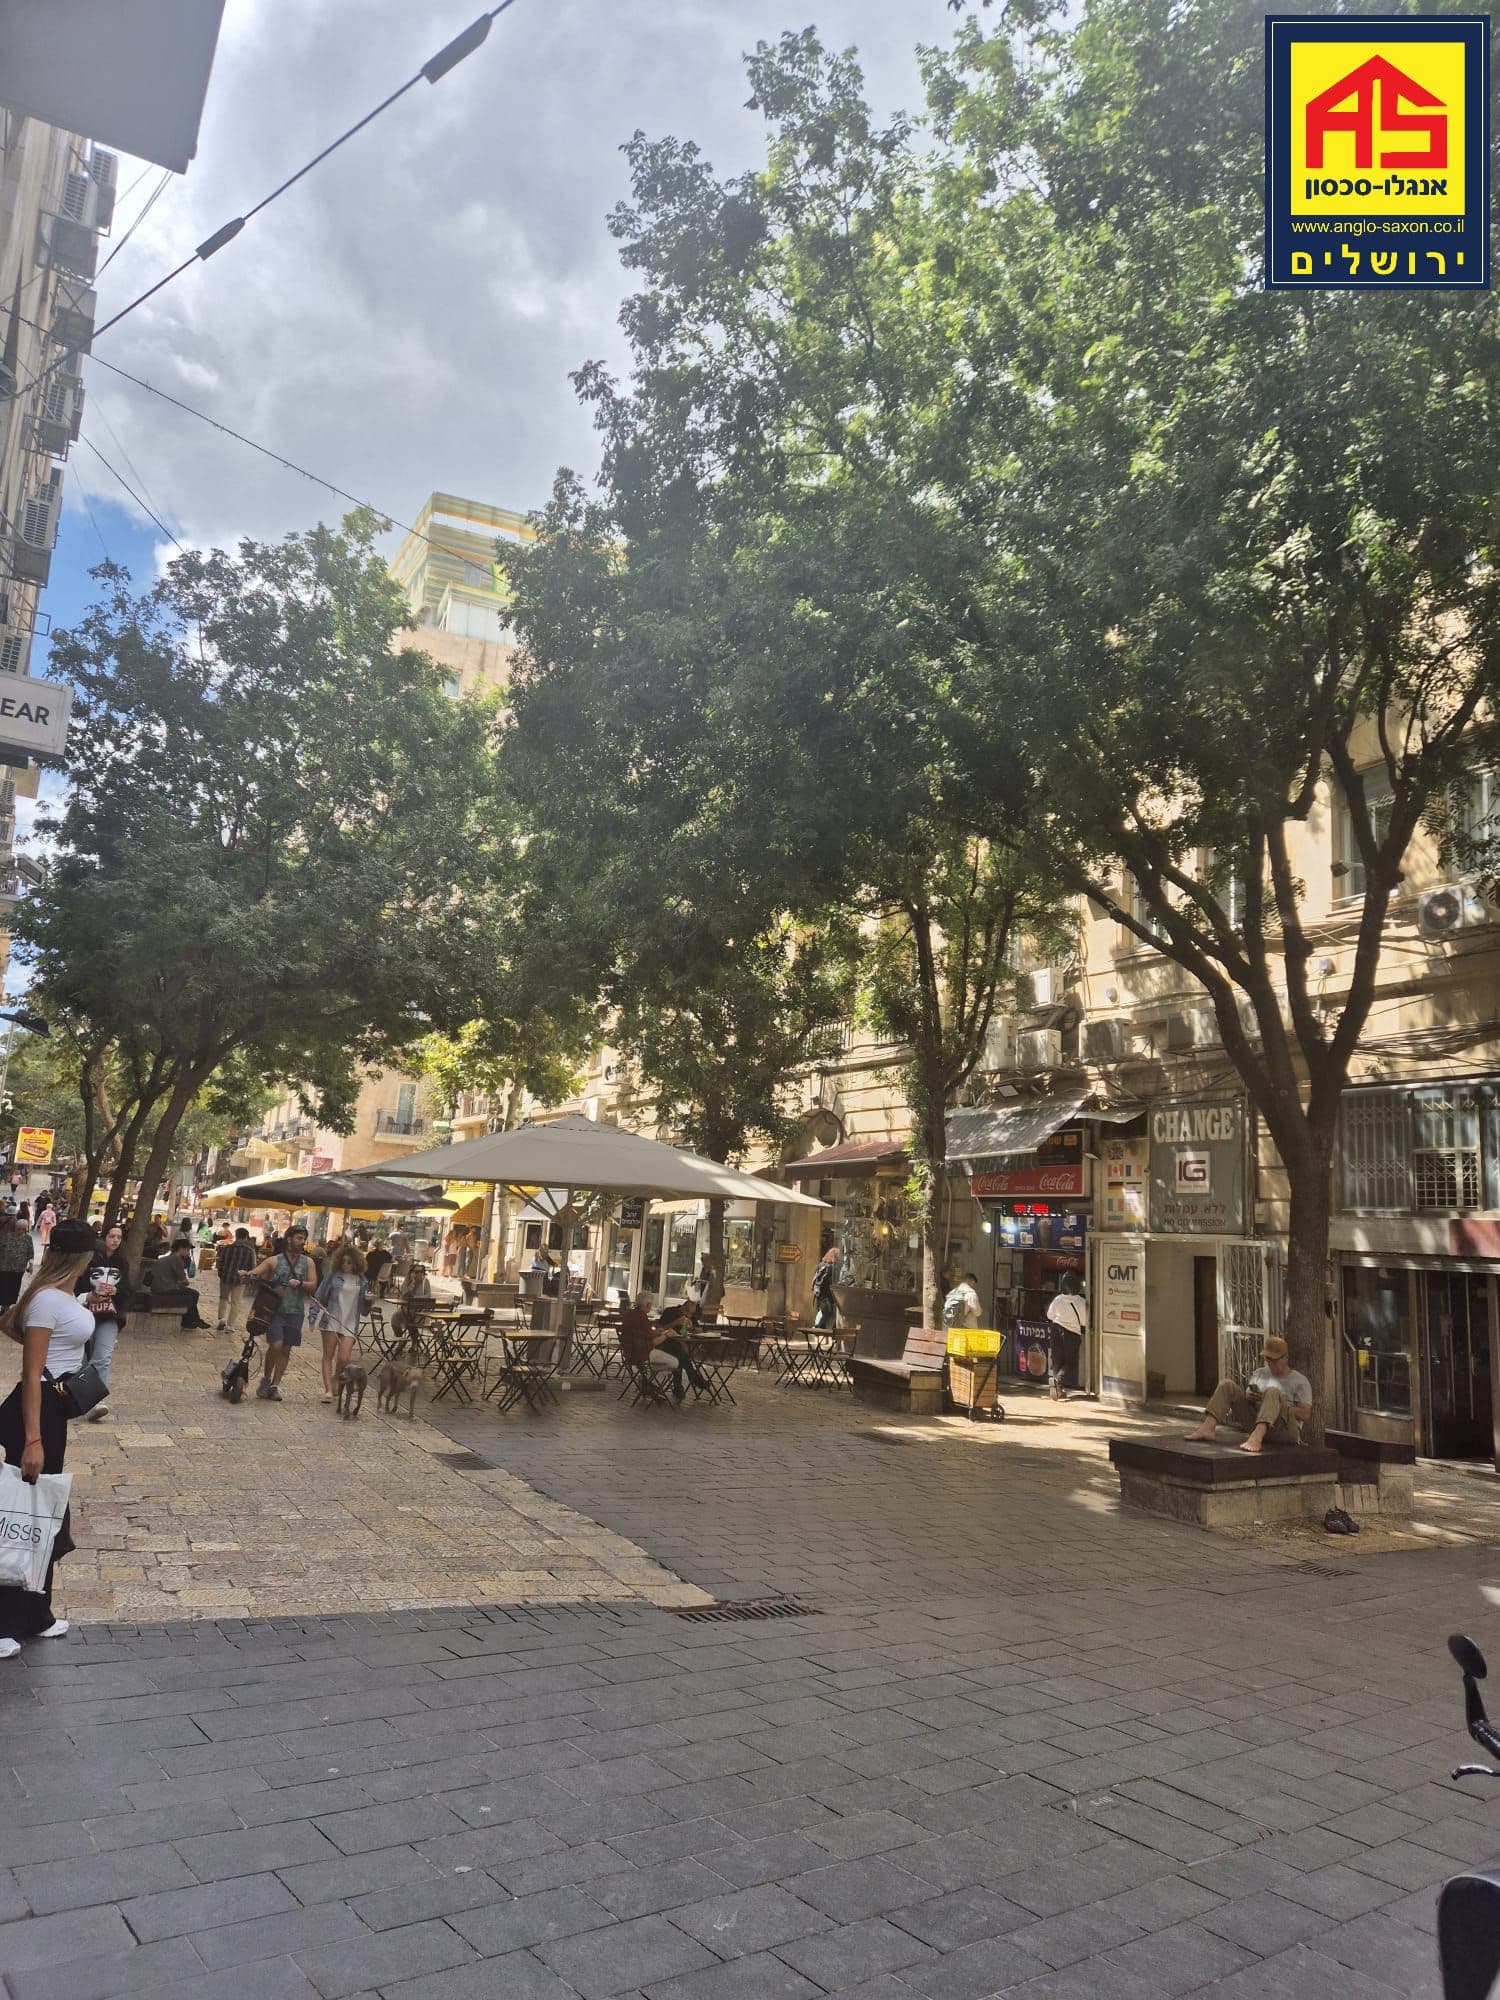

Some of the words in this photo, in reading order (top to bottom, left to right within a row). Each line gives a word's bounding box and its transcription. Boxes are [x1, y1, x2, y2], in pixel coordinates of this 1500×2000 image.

[0, 697, 50, 726] EAR
[1153, 1107, 1235, 1143] CHANGE
[1107, 1264, 1138, 1281] GMT
